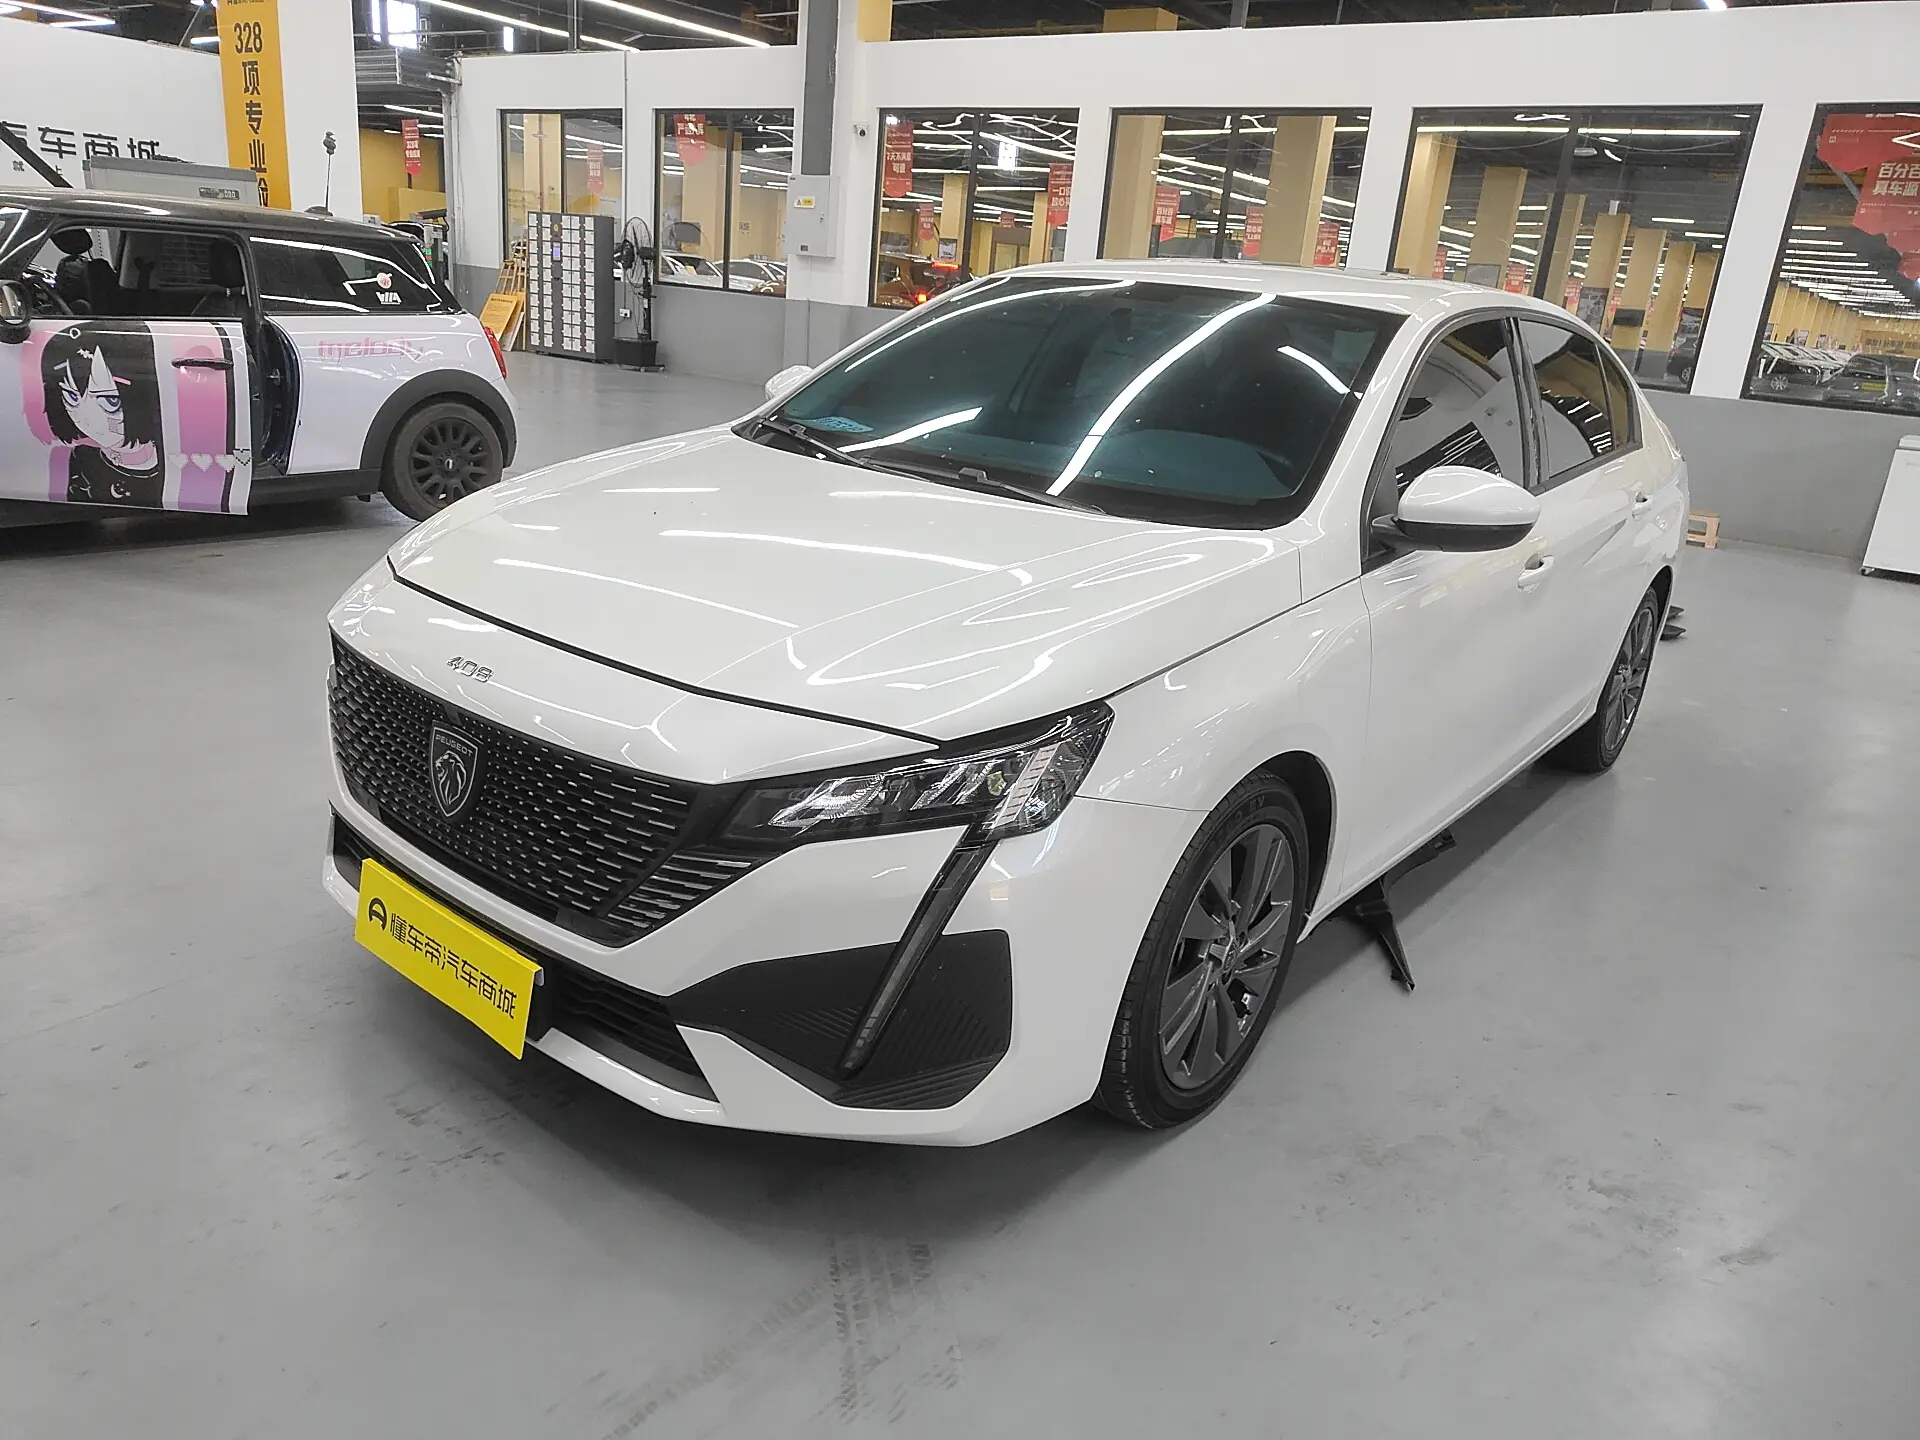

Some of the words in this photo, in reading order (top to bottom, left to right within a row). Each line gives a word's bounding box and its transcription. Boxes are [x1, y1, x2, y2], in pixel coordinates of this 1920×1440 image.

[446, 655, 494, 683] 408
[435, 734, 474, 757] PEUGEOT
[389, 912, 518, 1020] 懂车帝汽车商城
